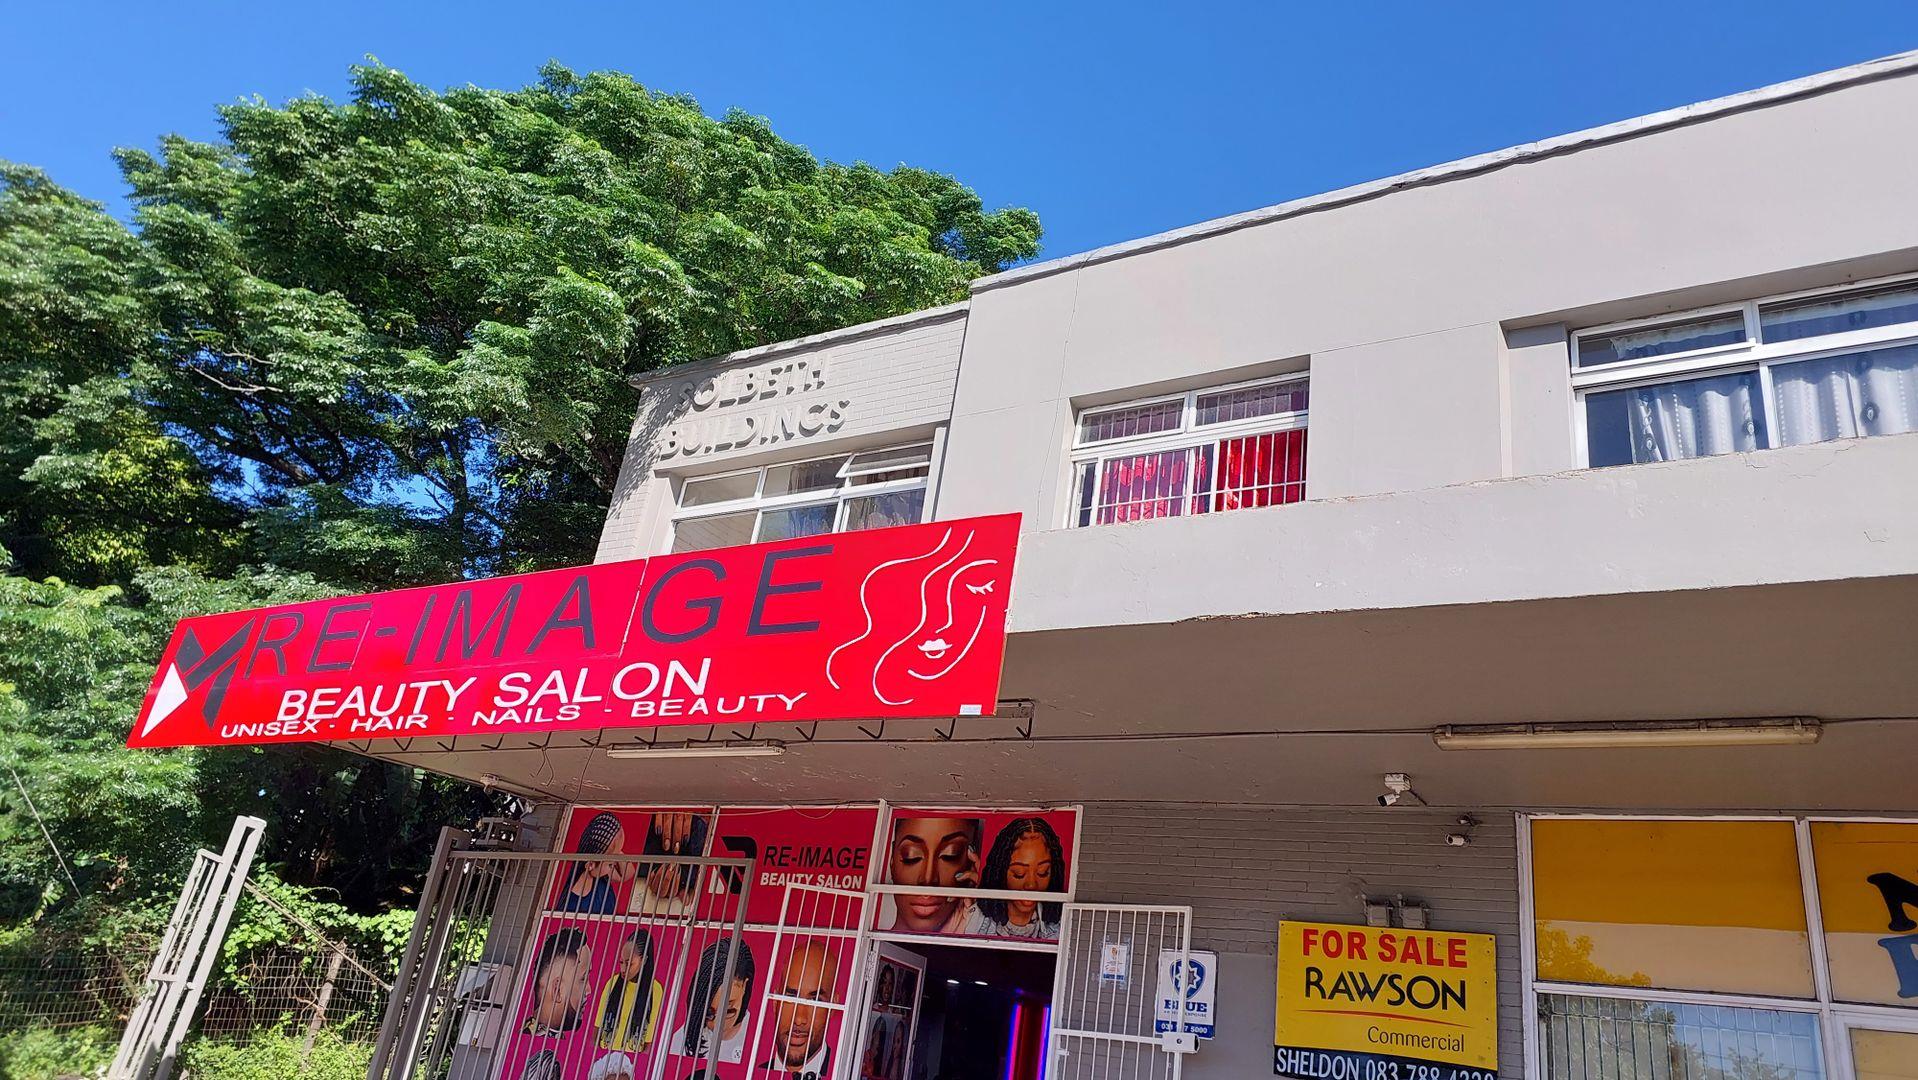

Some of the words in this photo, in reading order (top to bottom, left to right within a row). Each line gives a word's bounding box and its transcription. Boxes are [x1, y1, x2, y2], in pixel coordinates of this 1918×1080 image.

[674, 353, 830, 416] SOLBETH
[660, 398, 851, 461] BUILDINGS
[245, 545, 834, 679] RE-IMAGE
[276, 676, 477, 722] BEAUTY
[494, 658, 712, 708] SALON
[221, 718, 318, 738] UNISEX
[350, 714, 429, 732] HAIR
[472, 705, 581, 726] NAILS
[630, 693, 808, 718] BEAUTY
[763, 845, 868, 870] RE-IMAGE
[760, 872, 814, 887] BEAUTY
[816, 874, 863, 889] SALON
[1302, 928, 1368, 961] FOR
[1377, 933, 1468, 969] SALE
[1304, 966, 1466, 1011] RAWSON
[1367, 1025, 1465, 1053] Commercial
[1276, 1048, 1360, 1080] SHELDON
[1365, 1059, 1399, 1080] 083
